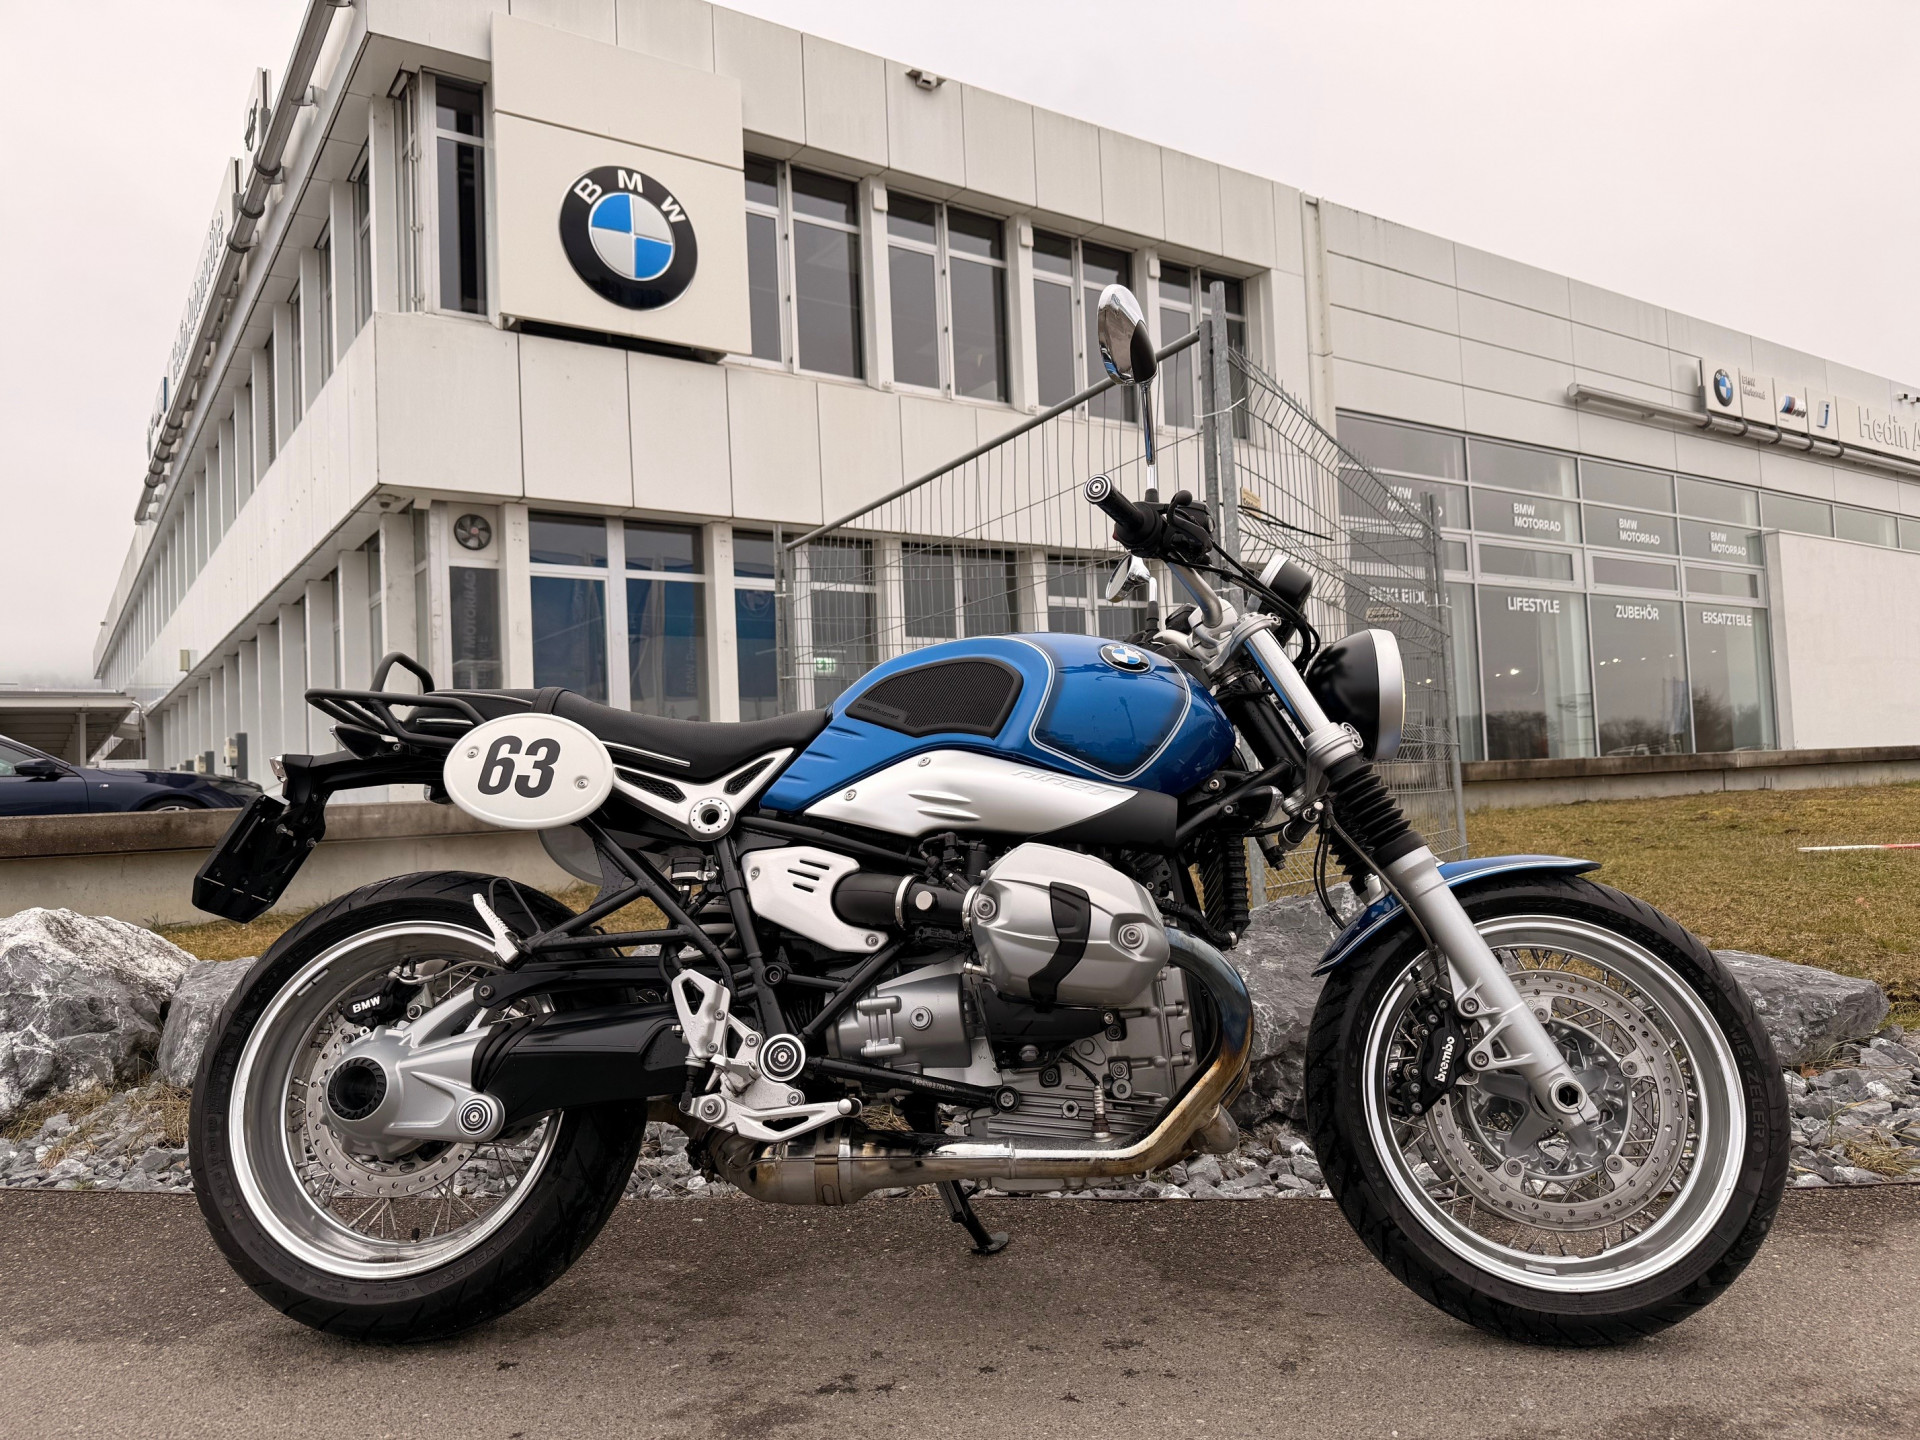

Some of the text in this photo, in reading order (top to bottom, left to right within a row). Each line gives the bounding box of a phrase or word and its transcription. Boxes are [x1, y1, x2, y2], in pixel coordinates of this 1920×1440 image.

[574, 169, 686, 224] BMW
[1857, 405, 1909, 450] Hedin
[1513, 502, 1536, 517] BMW
[1514, 516, 1561, 532] MOTORRAD
[1618, 518, 1638, 530] BMW
[1619, 530, 1661, 545] MOTORRAD
[1710, 531, 1727, 543] BMW
[1711, 543, 1747, 556] MOTORRAD
[1507, 596, 1560, 614] LIFESTYLE
[1615, 604, 1660, 621] ZUBEHÖR
[1702, 611, 1753, 627] ERSATZTEILE
[478, 735, 561, 799] 63
[352, 995, 381, 1014] BMW
[1434, 1035, 1456, 1083] brembo
[1729, 1027, 1766, 1139] METZELER
